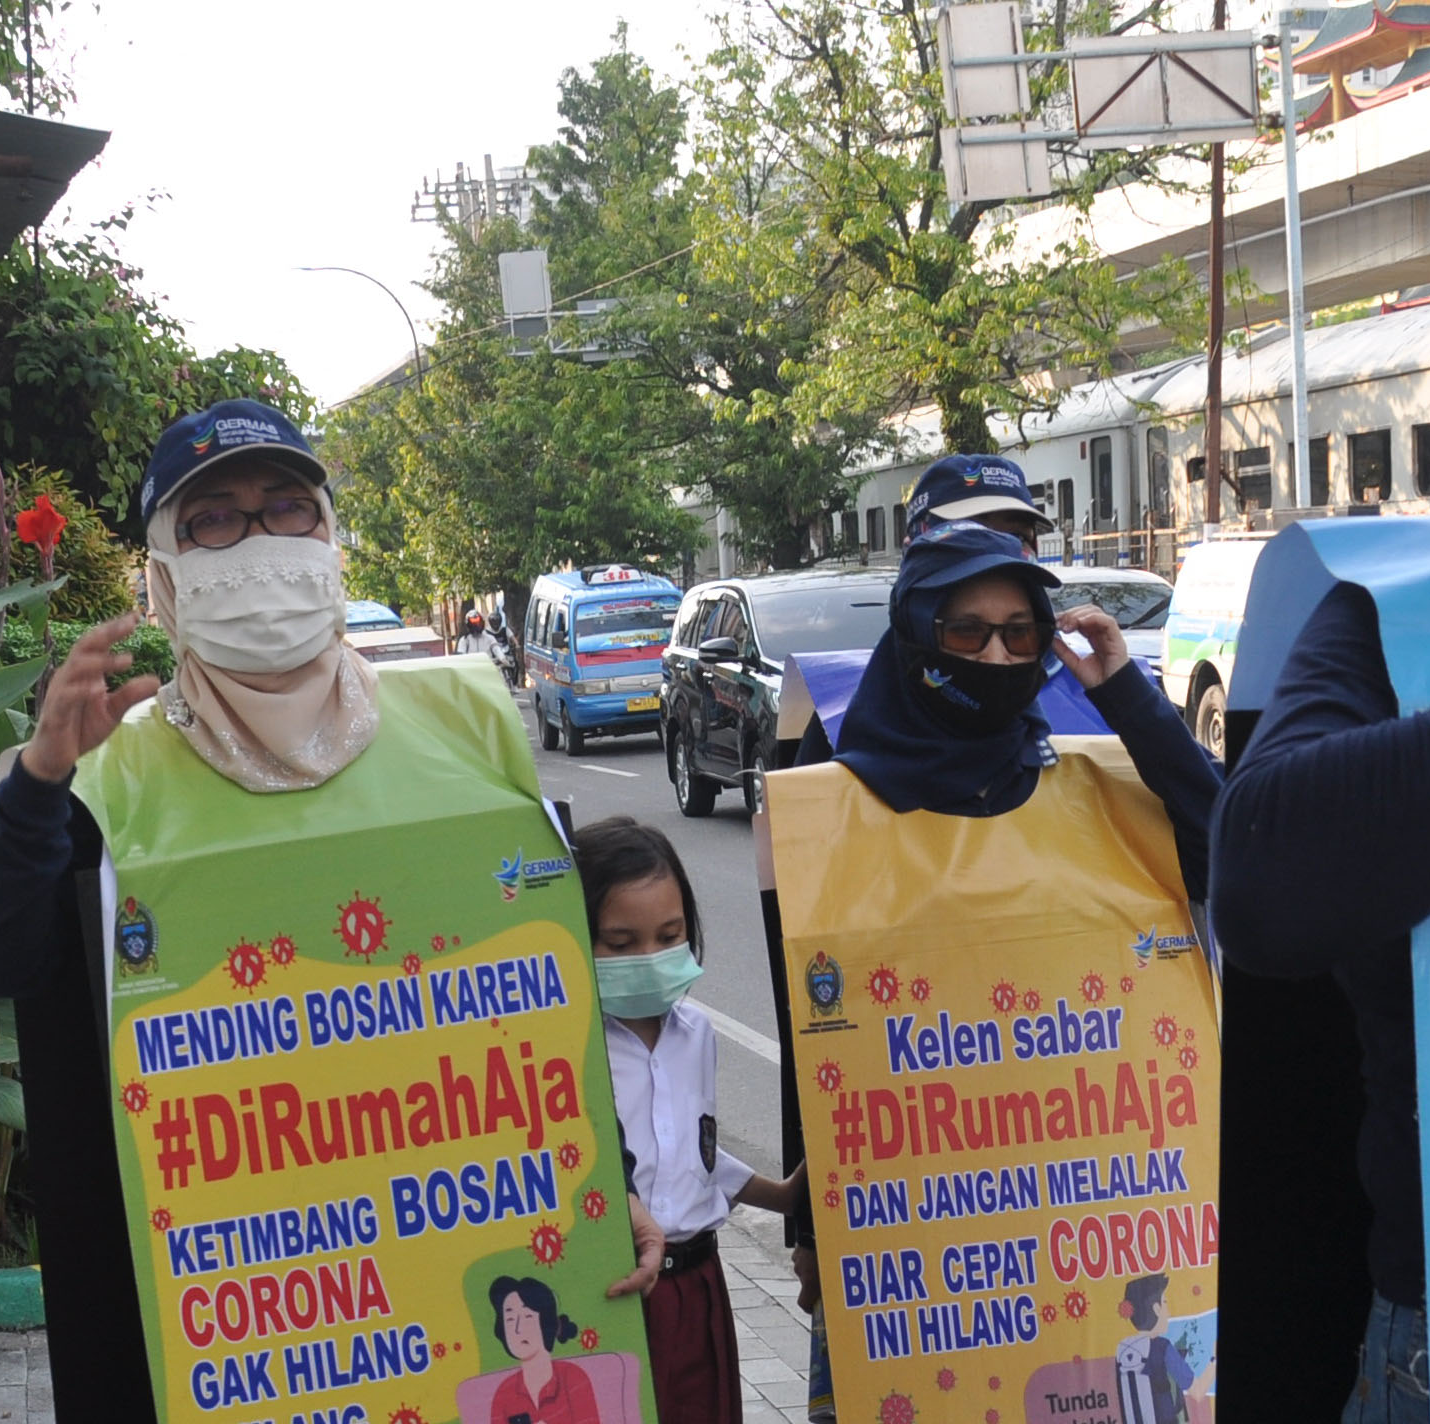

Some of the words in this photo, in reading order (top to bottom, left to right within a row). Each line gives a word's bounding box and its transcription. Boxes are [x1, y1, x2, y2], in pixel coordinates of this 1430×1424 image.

[215, 418, 278, 434] GERMAS
[522, 857, 572, 876] GERMAS
[135, 996, 300, 1074] MENDING
[305, 977, 425, 1047] BOSAN
[429, 954, 567, 1025] KARENA
[885, 1011, 1002, 1073] Kelen
[1013, 999, 1122, 1060] sabar
[152, 1041, 581, 1191] #DiRumahAja
[832, 1059, 1197, 1165] #DiRumahAja
[168, 1196, 378, 1277] KETIMBANG
[391, 1152, 558, 1238] BOSAN
[846, 1180, 910, 1229] DAN
[917, 1166, 1040, 1221] JANGAN
[1046, 1149, 1188, 1206] MELALAK
[842, 1250, 928, 1308] BIAR
[942, 1238, 1038, 1294] CEPAT
[1050, 1203, 1218, 1283] CORONA
[181, 1257, 391, 1348] CORONA
[865, 1310, 911, 1360] INI
[917, 1295, 1038, 1354] HILANG
[191, 1351, 278, 1411] GAK
[284, 1325, 430, 1395] HILANG
[1044, 1390, 1109, 1414] Tunda
